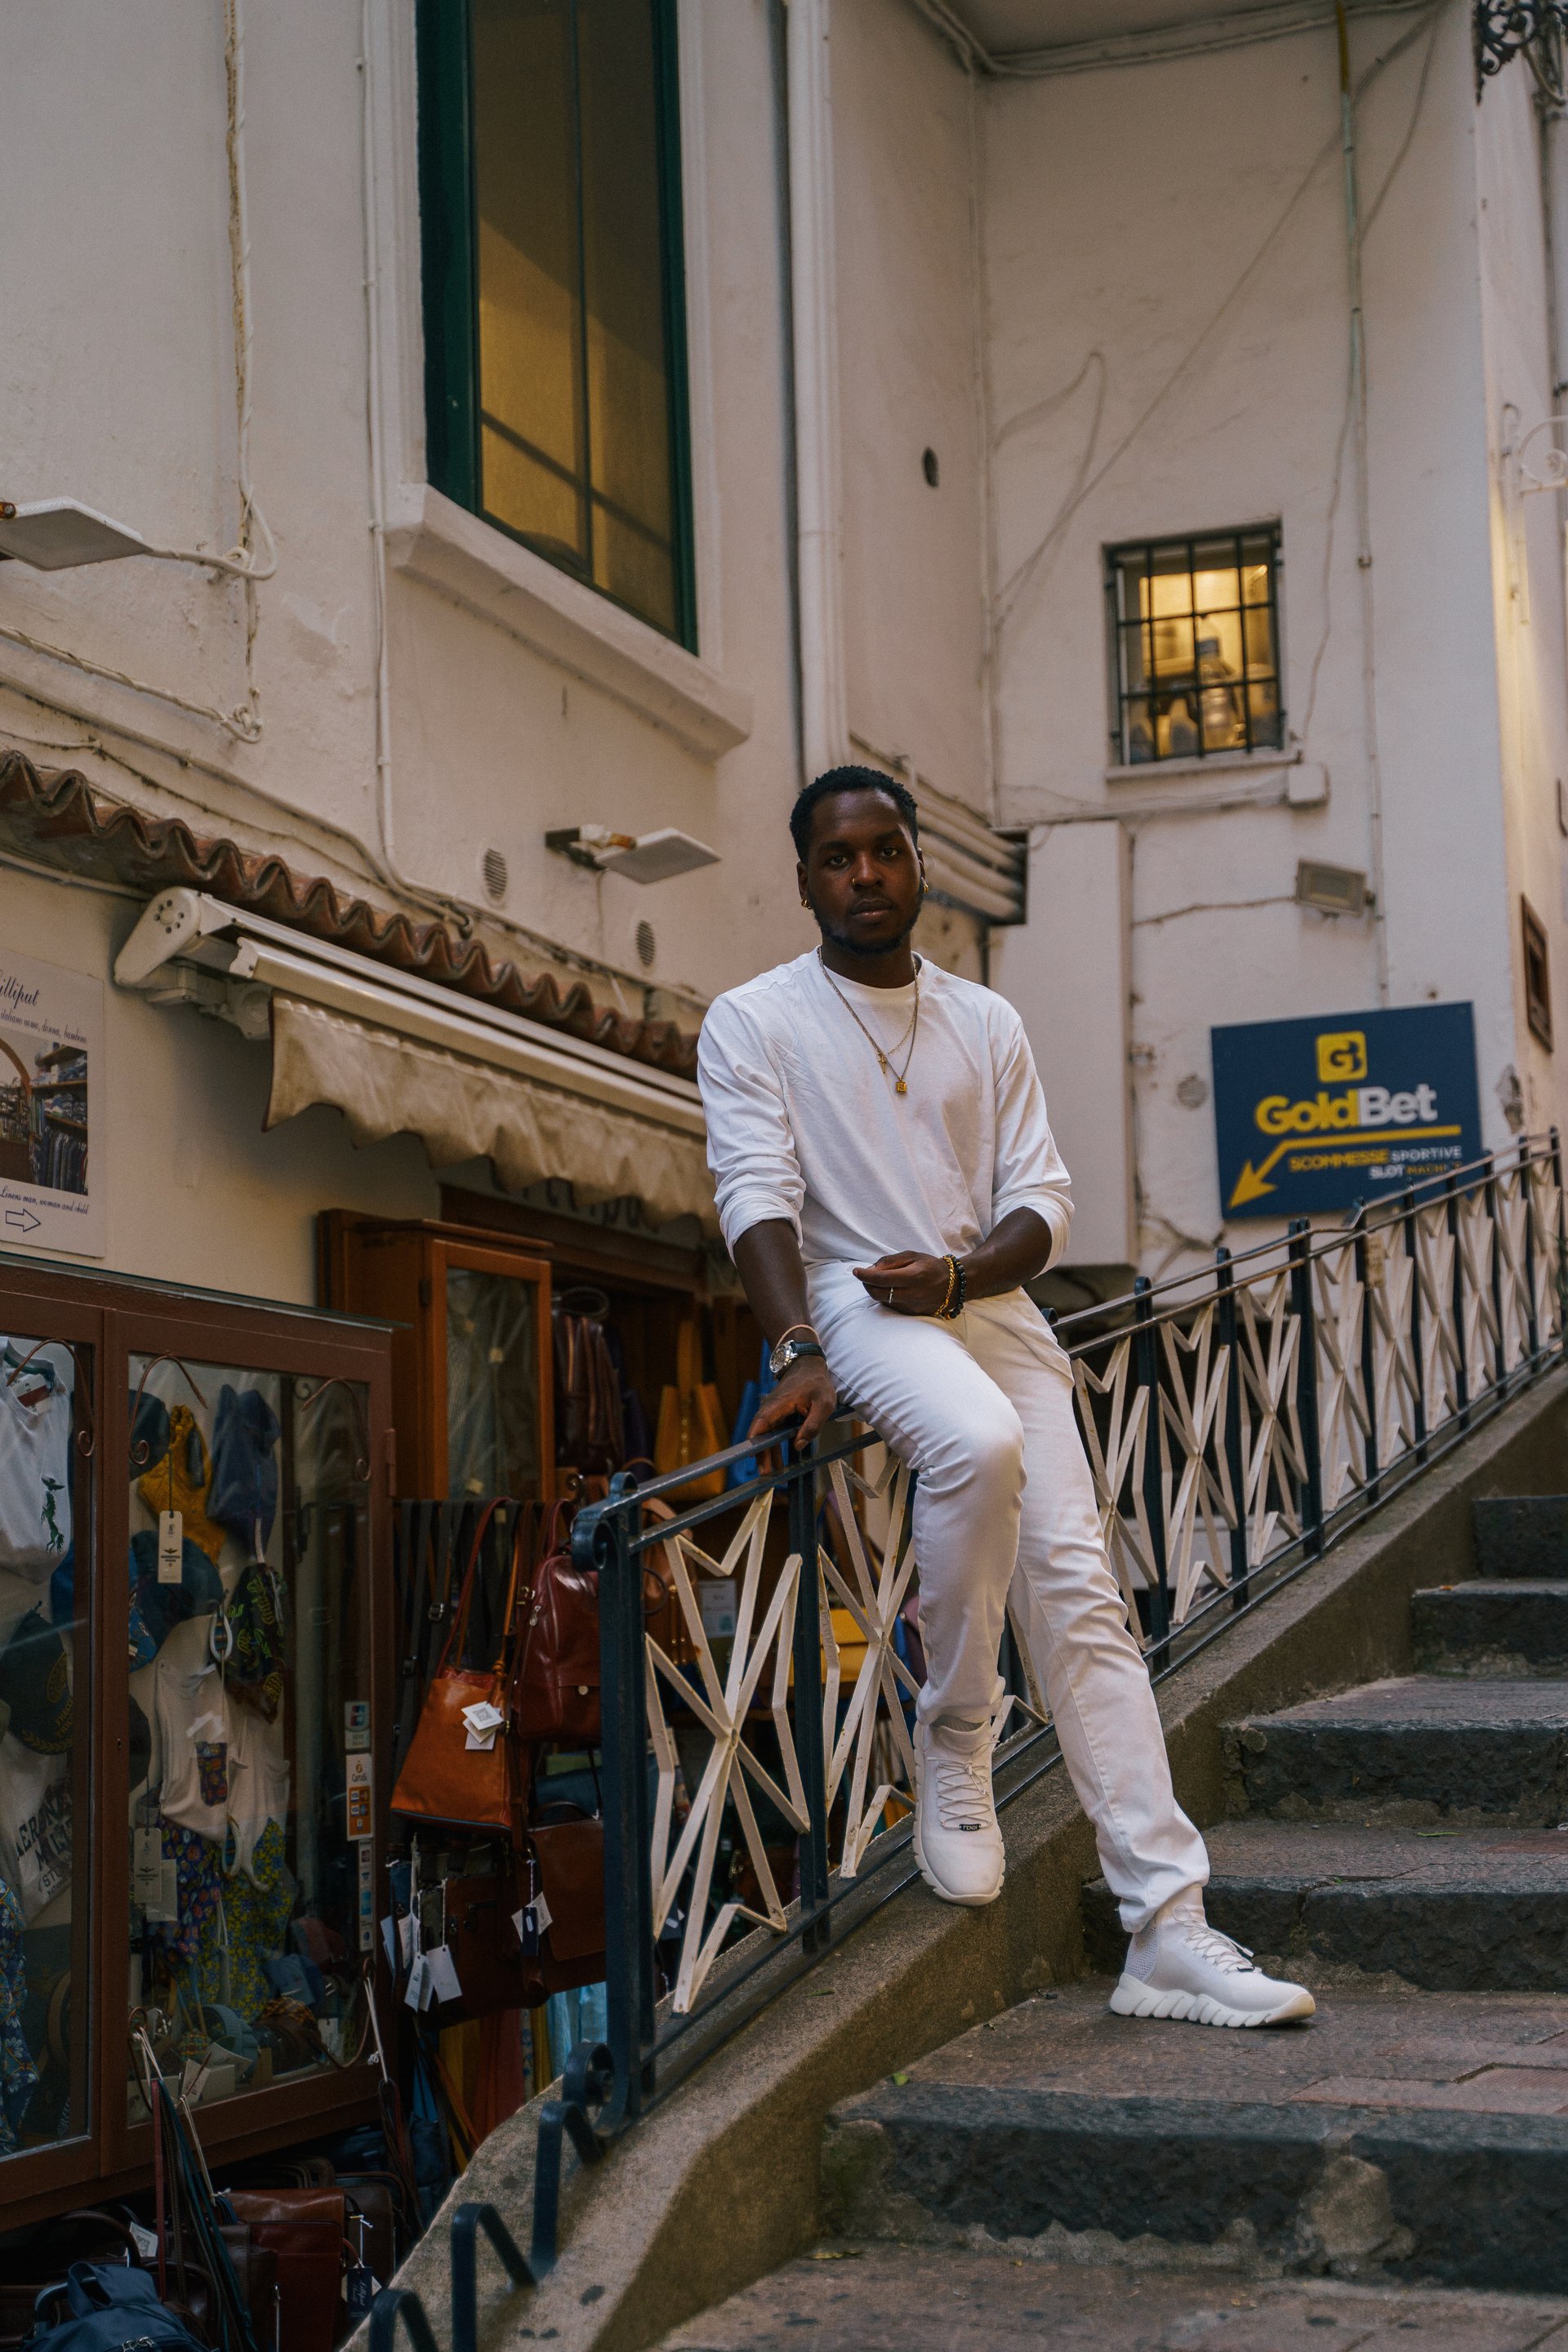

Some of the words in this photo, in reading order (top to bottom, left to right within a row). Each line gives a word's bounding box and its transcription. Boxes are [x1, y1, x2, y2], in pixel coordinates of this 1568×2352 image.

[0, 972, 39, 1009] illiput
[64, 1025, 87, 1045] bambino
[1254, 1084, 1438, 1134] GoldBet
[1290, 1148, 1389, 1172] SCOMMESSE
[1390, 1146, 1463, 1164] SPORTIVE
[1369, 1164, 1405, 1179] SLOT
[39, 1200, 60, 1209] woman
[62, 1200, 74, 1212] and
[74, 1201, 89, 1214] child
